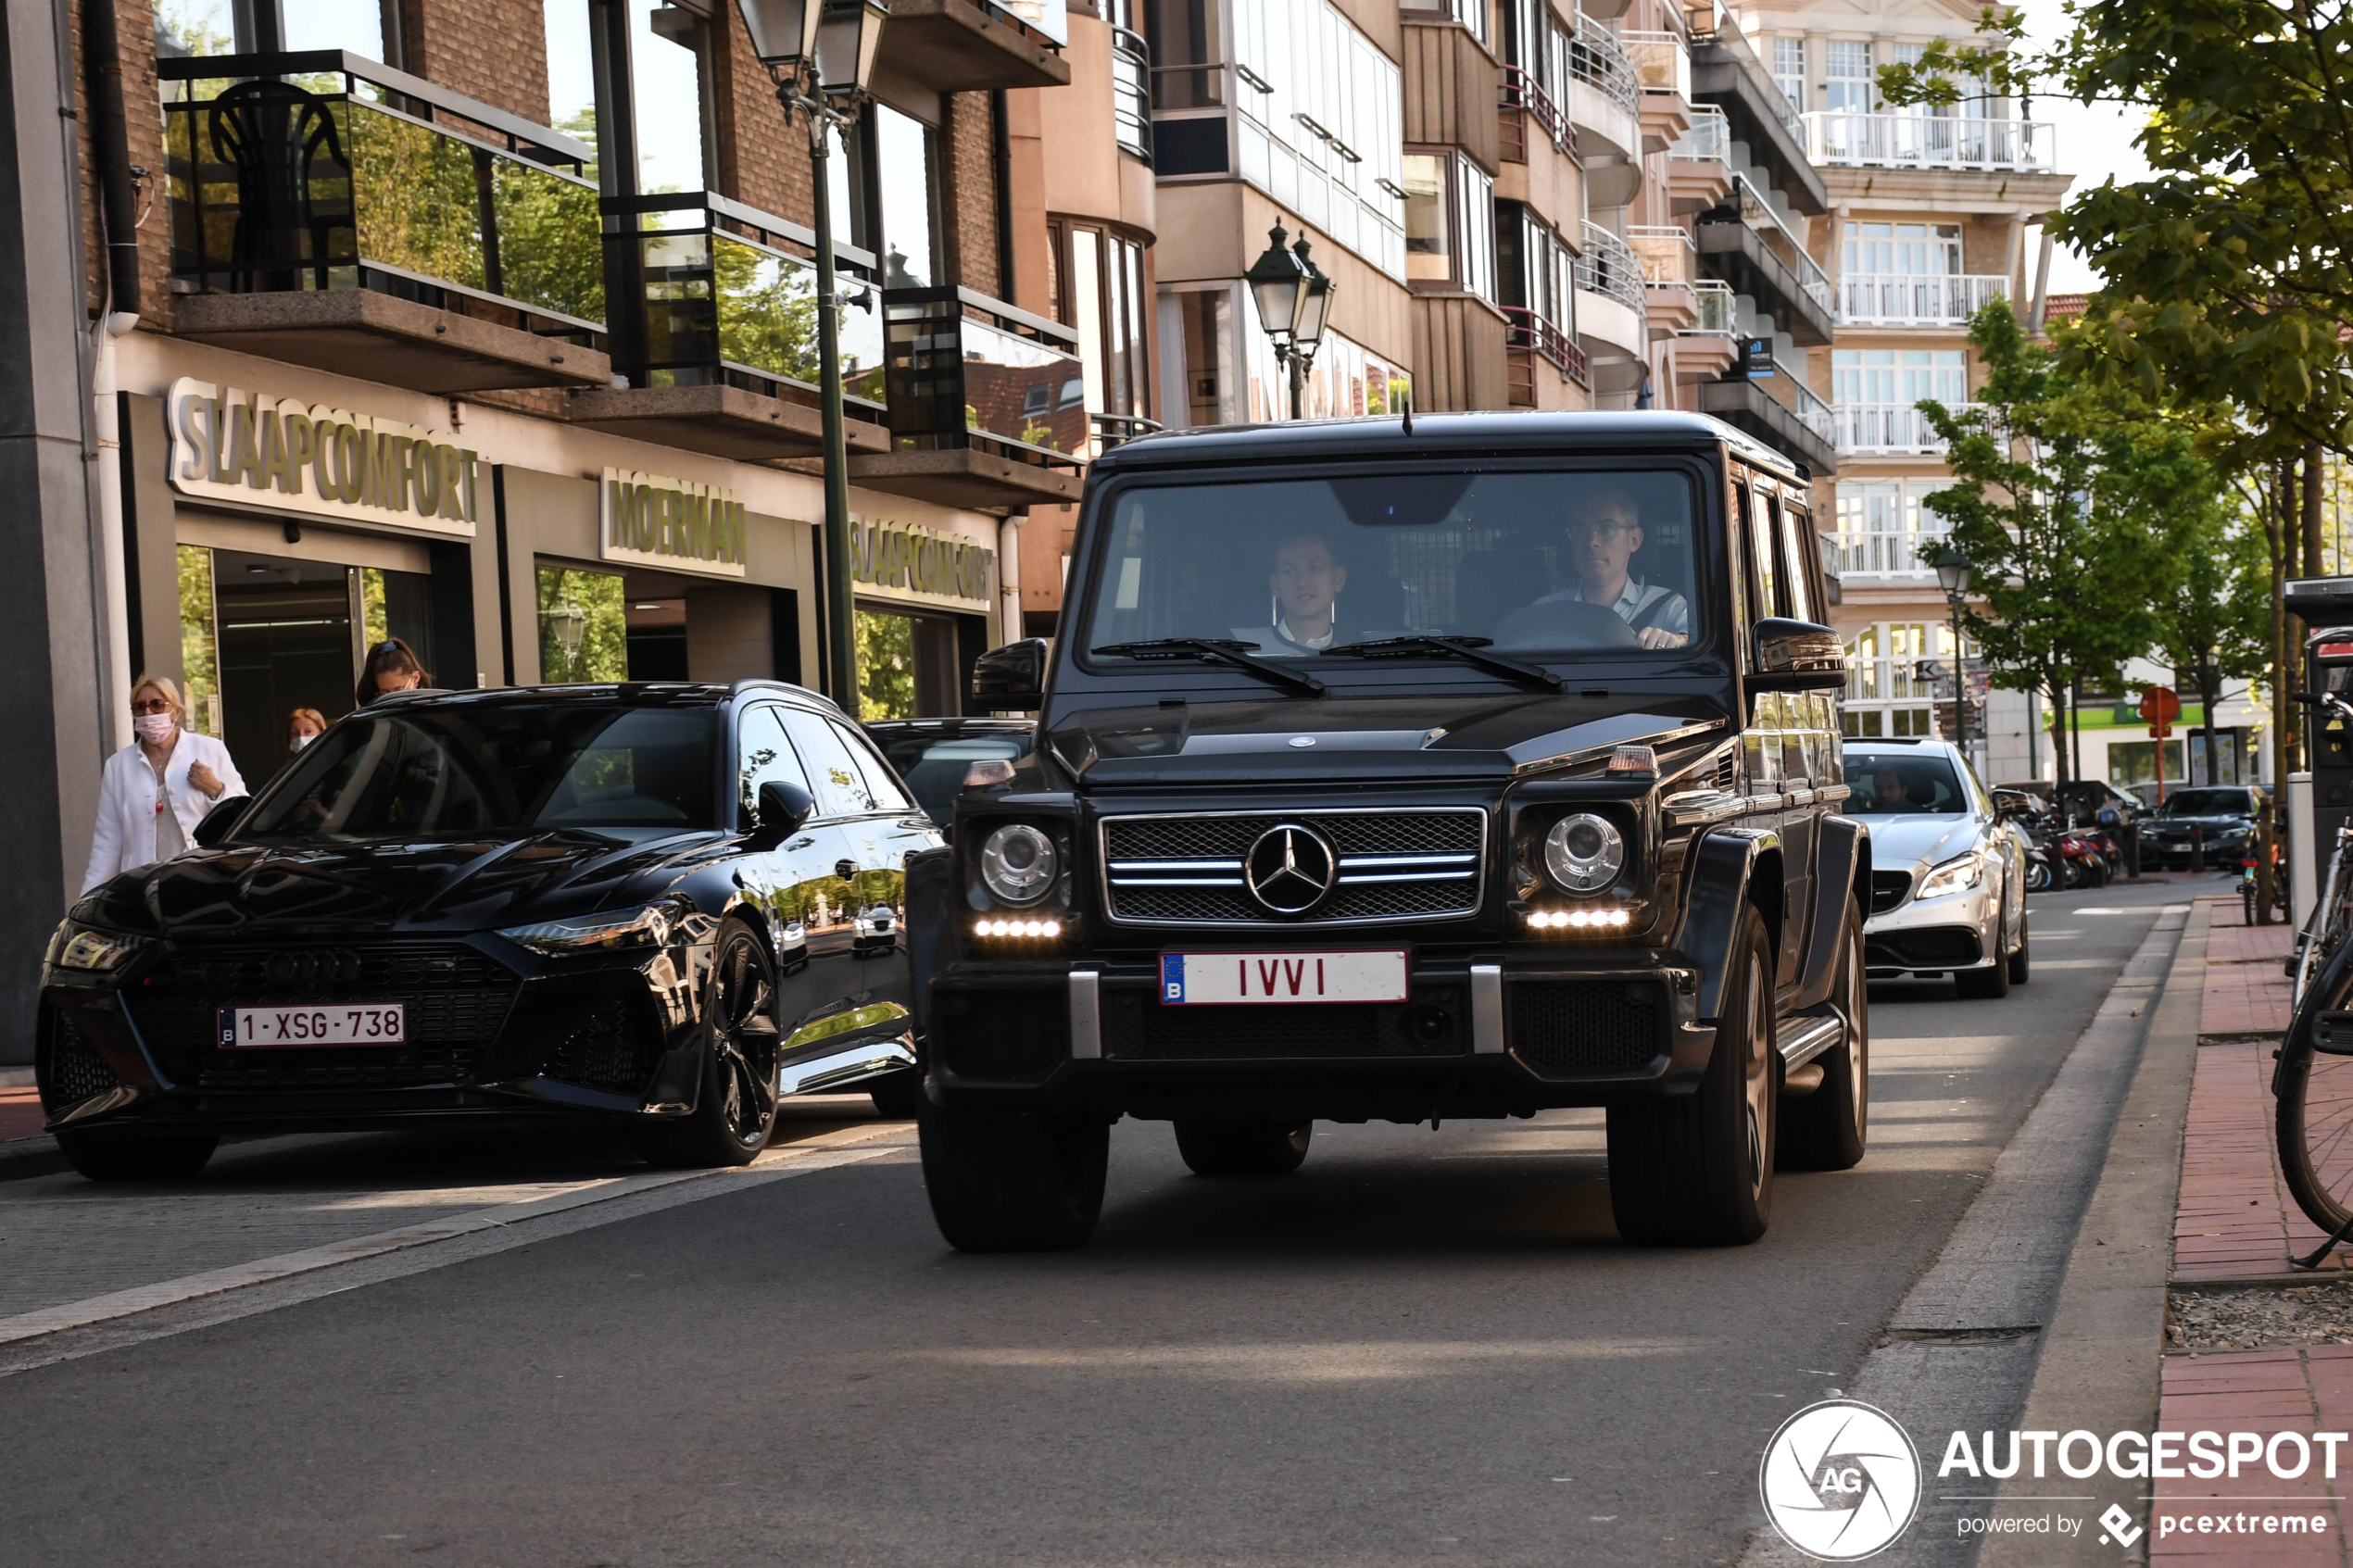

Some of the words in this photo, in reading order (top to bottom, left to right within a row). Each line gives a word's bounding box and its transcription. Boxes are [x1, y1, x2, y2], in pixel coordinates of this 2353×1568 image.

[179, 394, 478, 522] SLAAPCOMFORT
[608, 480, 747, 565] MOERMAN
[849, 521, 993, 601] SLAAPCOMFORT
[1167, 982, 1182, 999] B
[222, 1029, 234, 1042] B
[243, 1010, 400, 1040] 1-XSG-738
